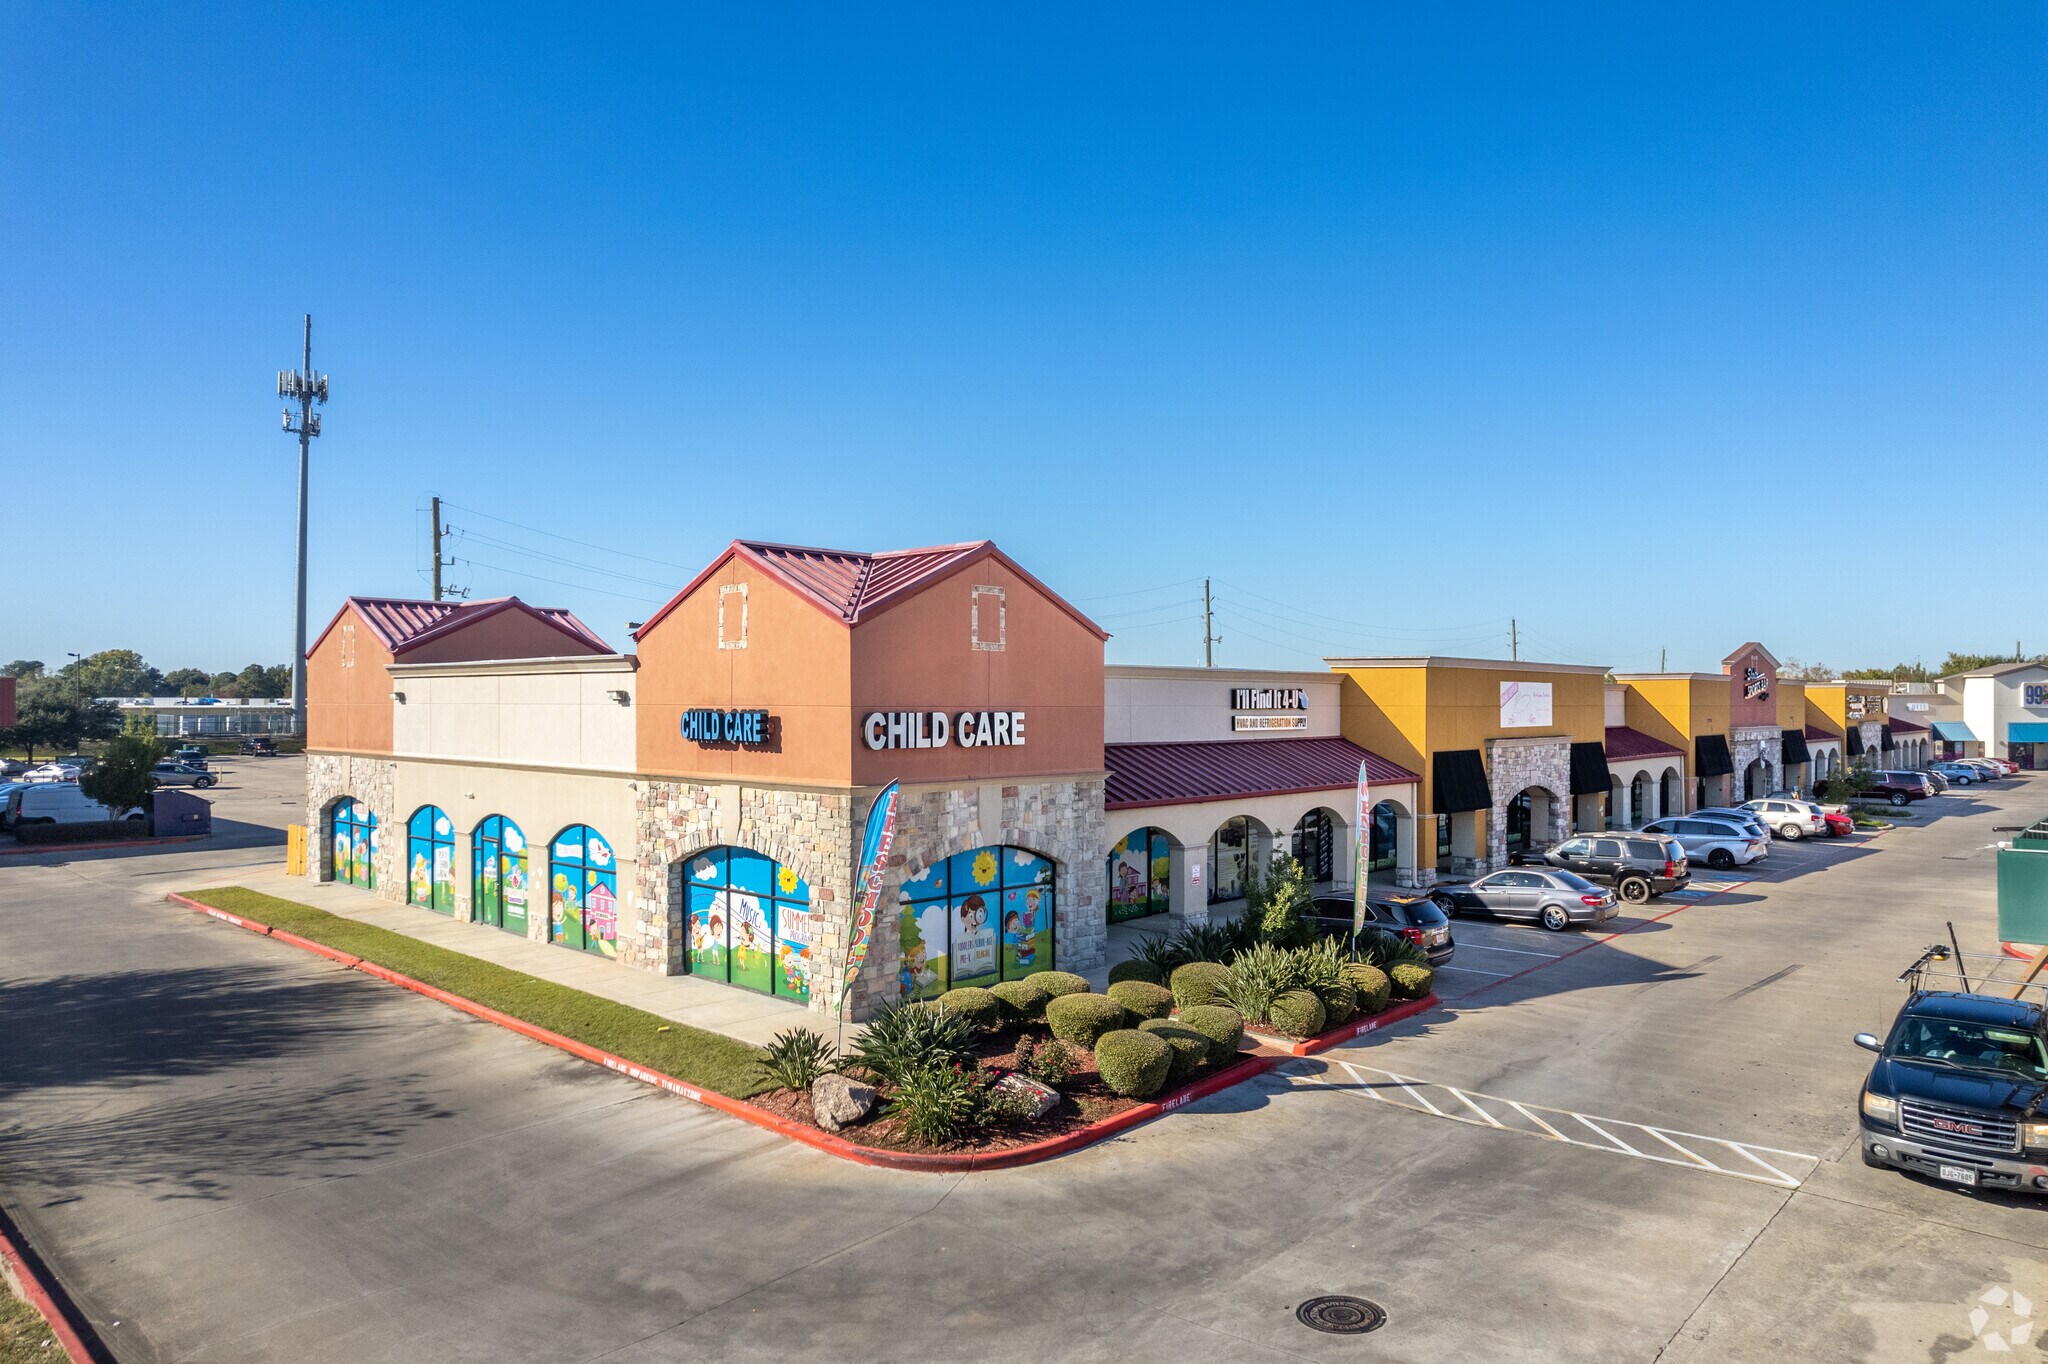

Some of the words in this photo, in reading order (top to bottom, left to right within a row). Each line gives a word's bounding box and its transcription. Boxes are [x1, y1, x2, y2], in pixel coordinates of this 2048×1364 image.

[1236, 689, 1250, 709] I'll
[1251, 689, 1273, 709] Find
[1273, 689, 1282, 709] It
[1282, 689, 1299, 709] 4-U
[681, 711, 720, 740] CHILD
[724, 712, 761, 742] CARE
[864, 711, 949, 750] CHILD
[957, 711, 1026, 748] CARE
[1249, 718, 1259, 728] AND
[1259, 717, 1291, 728] REFRIGERATION
[1291, 717, 1307, 728] SUPPLY
[1933, 1118, 1983, 1136] GMC
